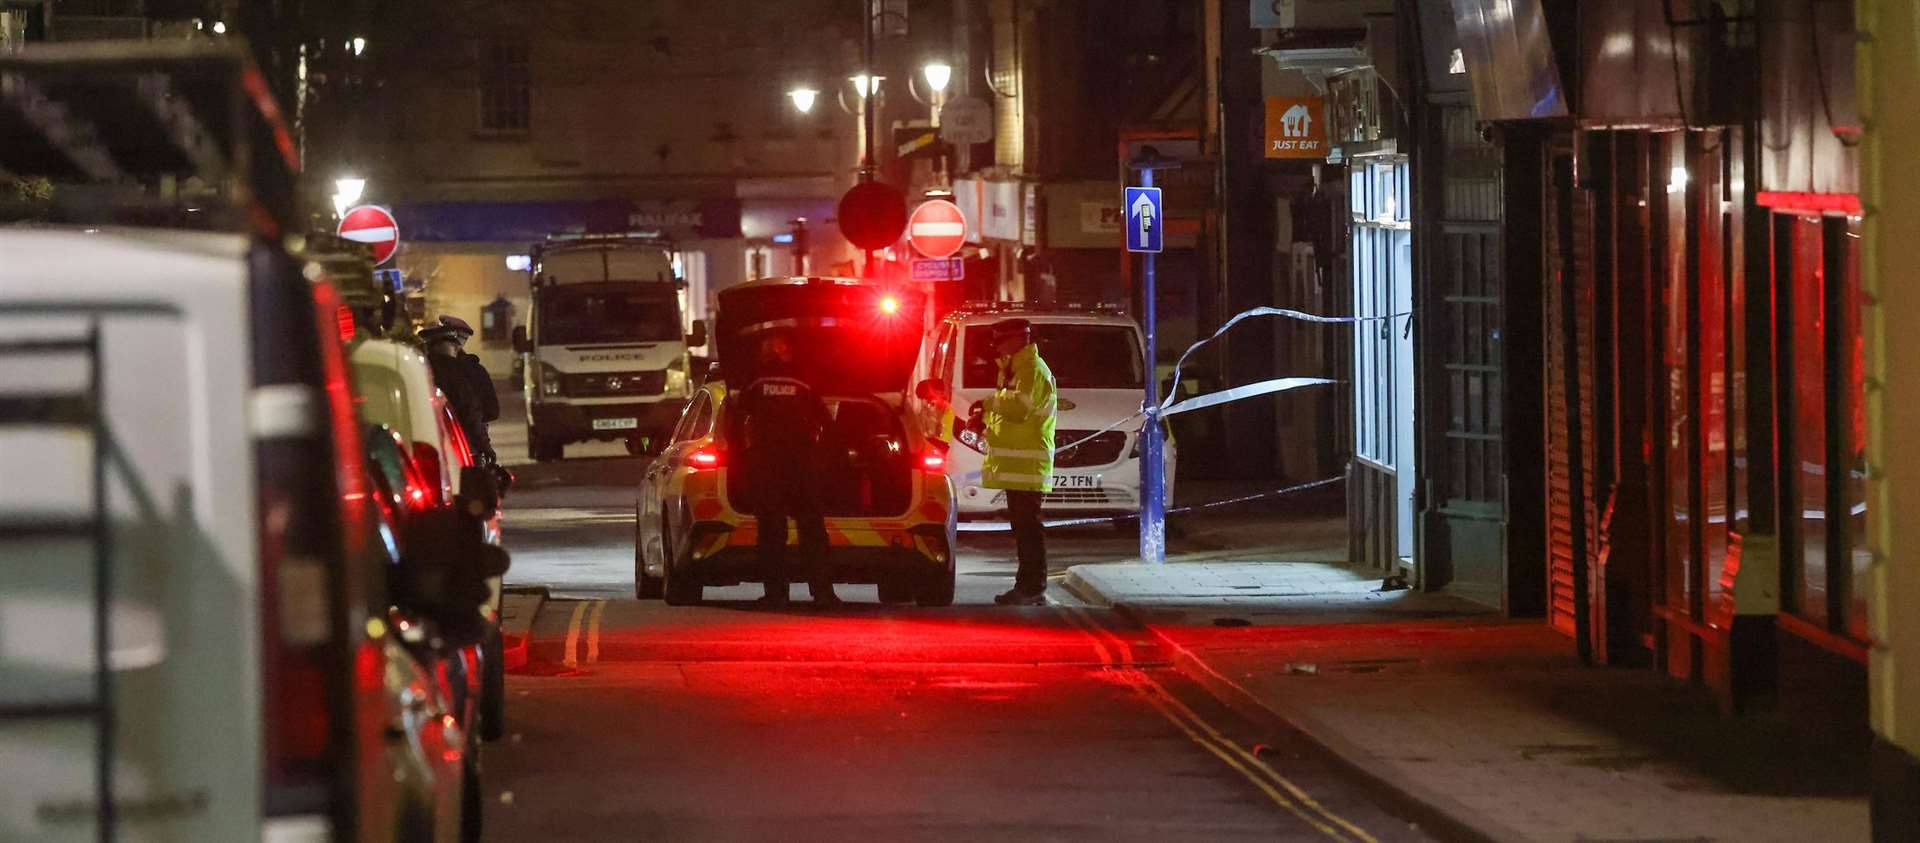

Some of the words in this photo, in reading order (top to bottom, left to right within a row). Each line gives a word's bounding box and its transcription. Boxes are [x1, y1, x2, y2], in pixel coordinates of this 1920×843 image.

[1272, 140, 1298, 151] JUST
[1299, 140, 1320, 150] EAT
[579, 353, 645, 362] POLICE
[763, 383, 797, 396] POLICE
[1070, 475, 1093, 487] TFN
